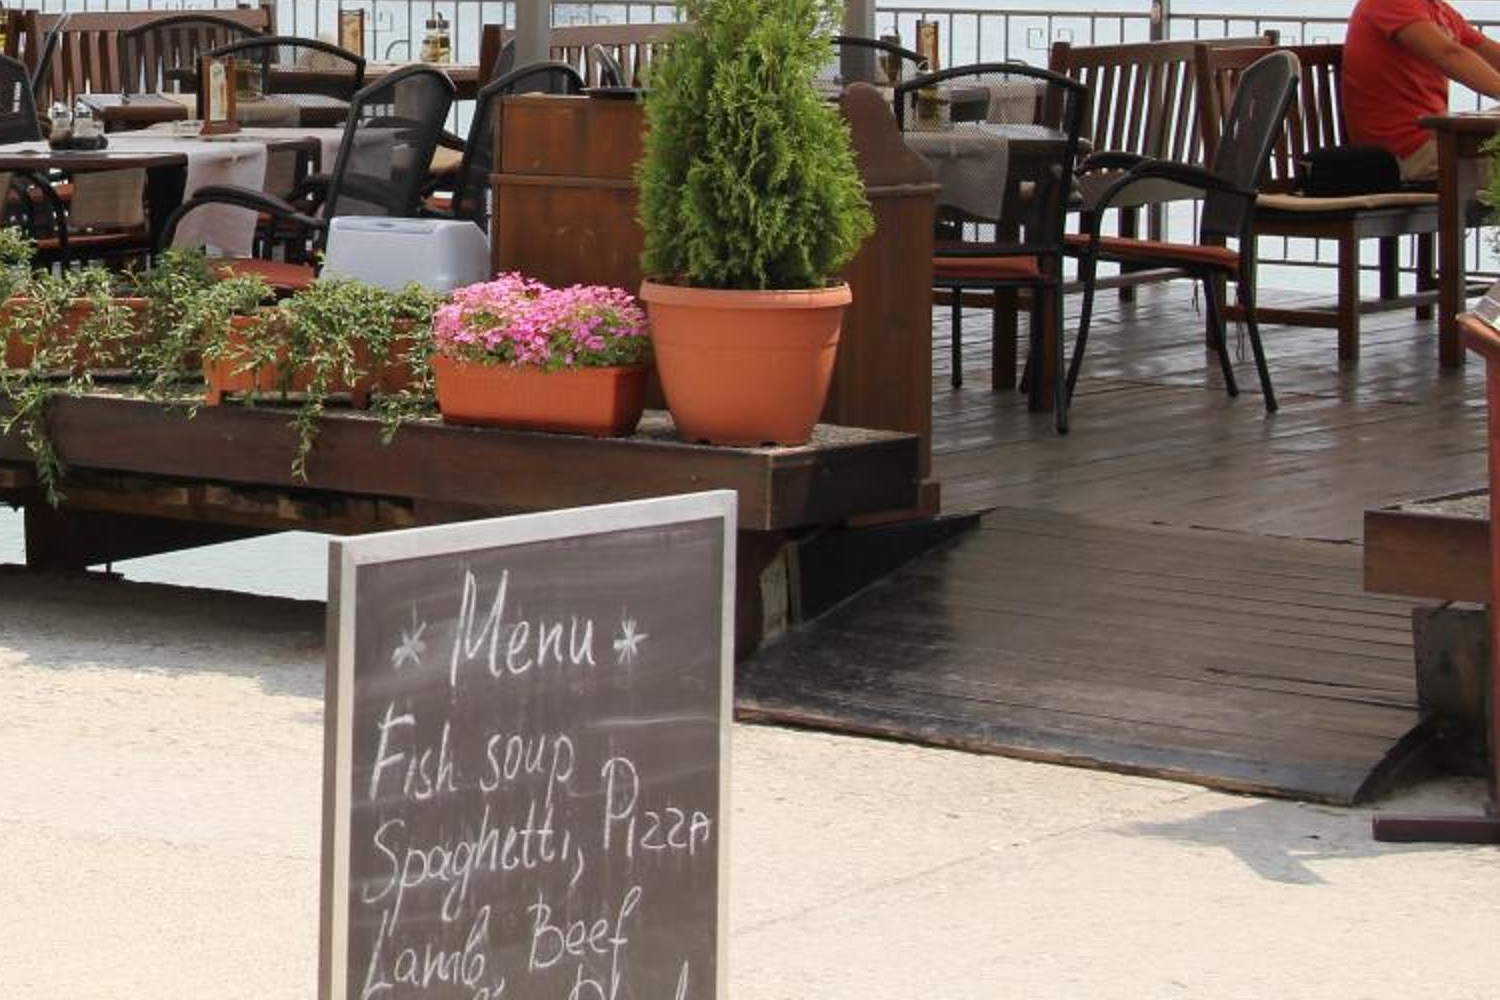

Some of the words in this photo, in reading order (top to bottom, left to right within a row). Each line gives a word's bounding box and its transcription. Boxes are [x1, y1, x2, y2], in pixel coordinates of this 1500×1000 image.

[450, 569, 597, 688] Menu
[368, 702, 458, 801] Fish
[478, 733, 575, 810] soup
[527, 885, 643, 1000] Beef
